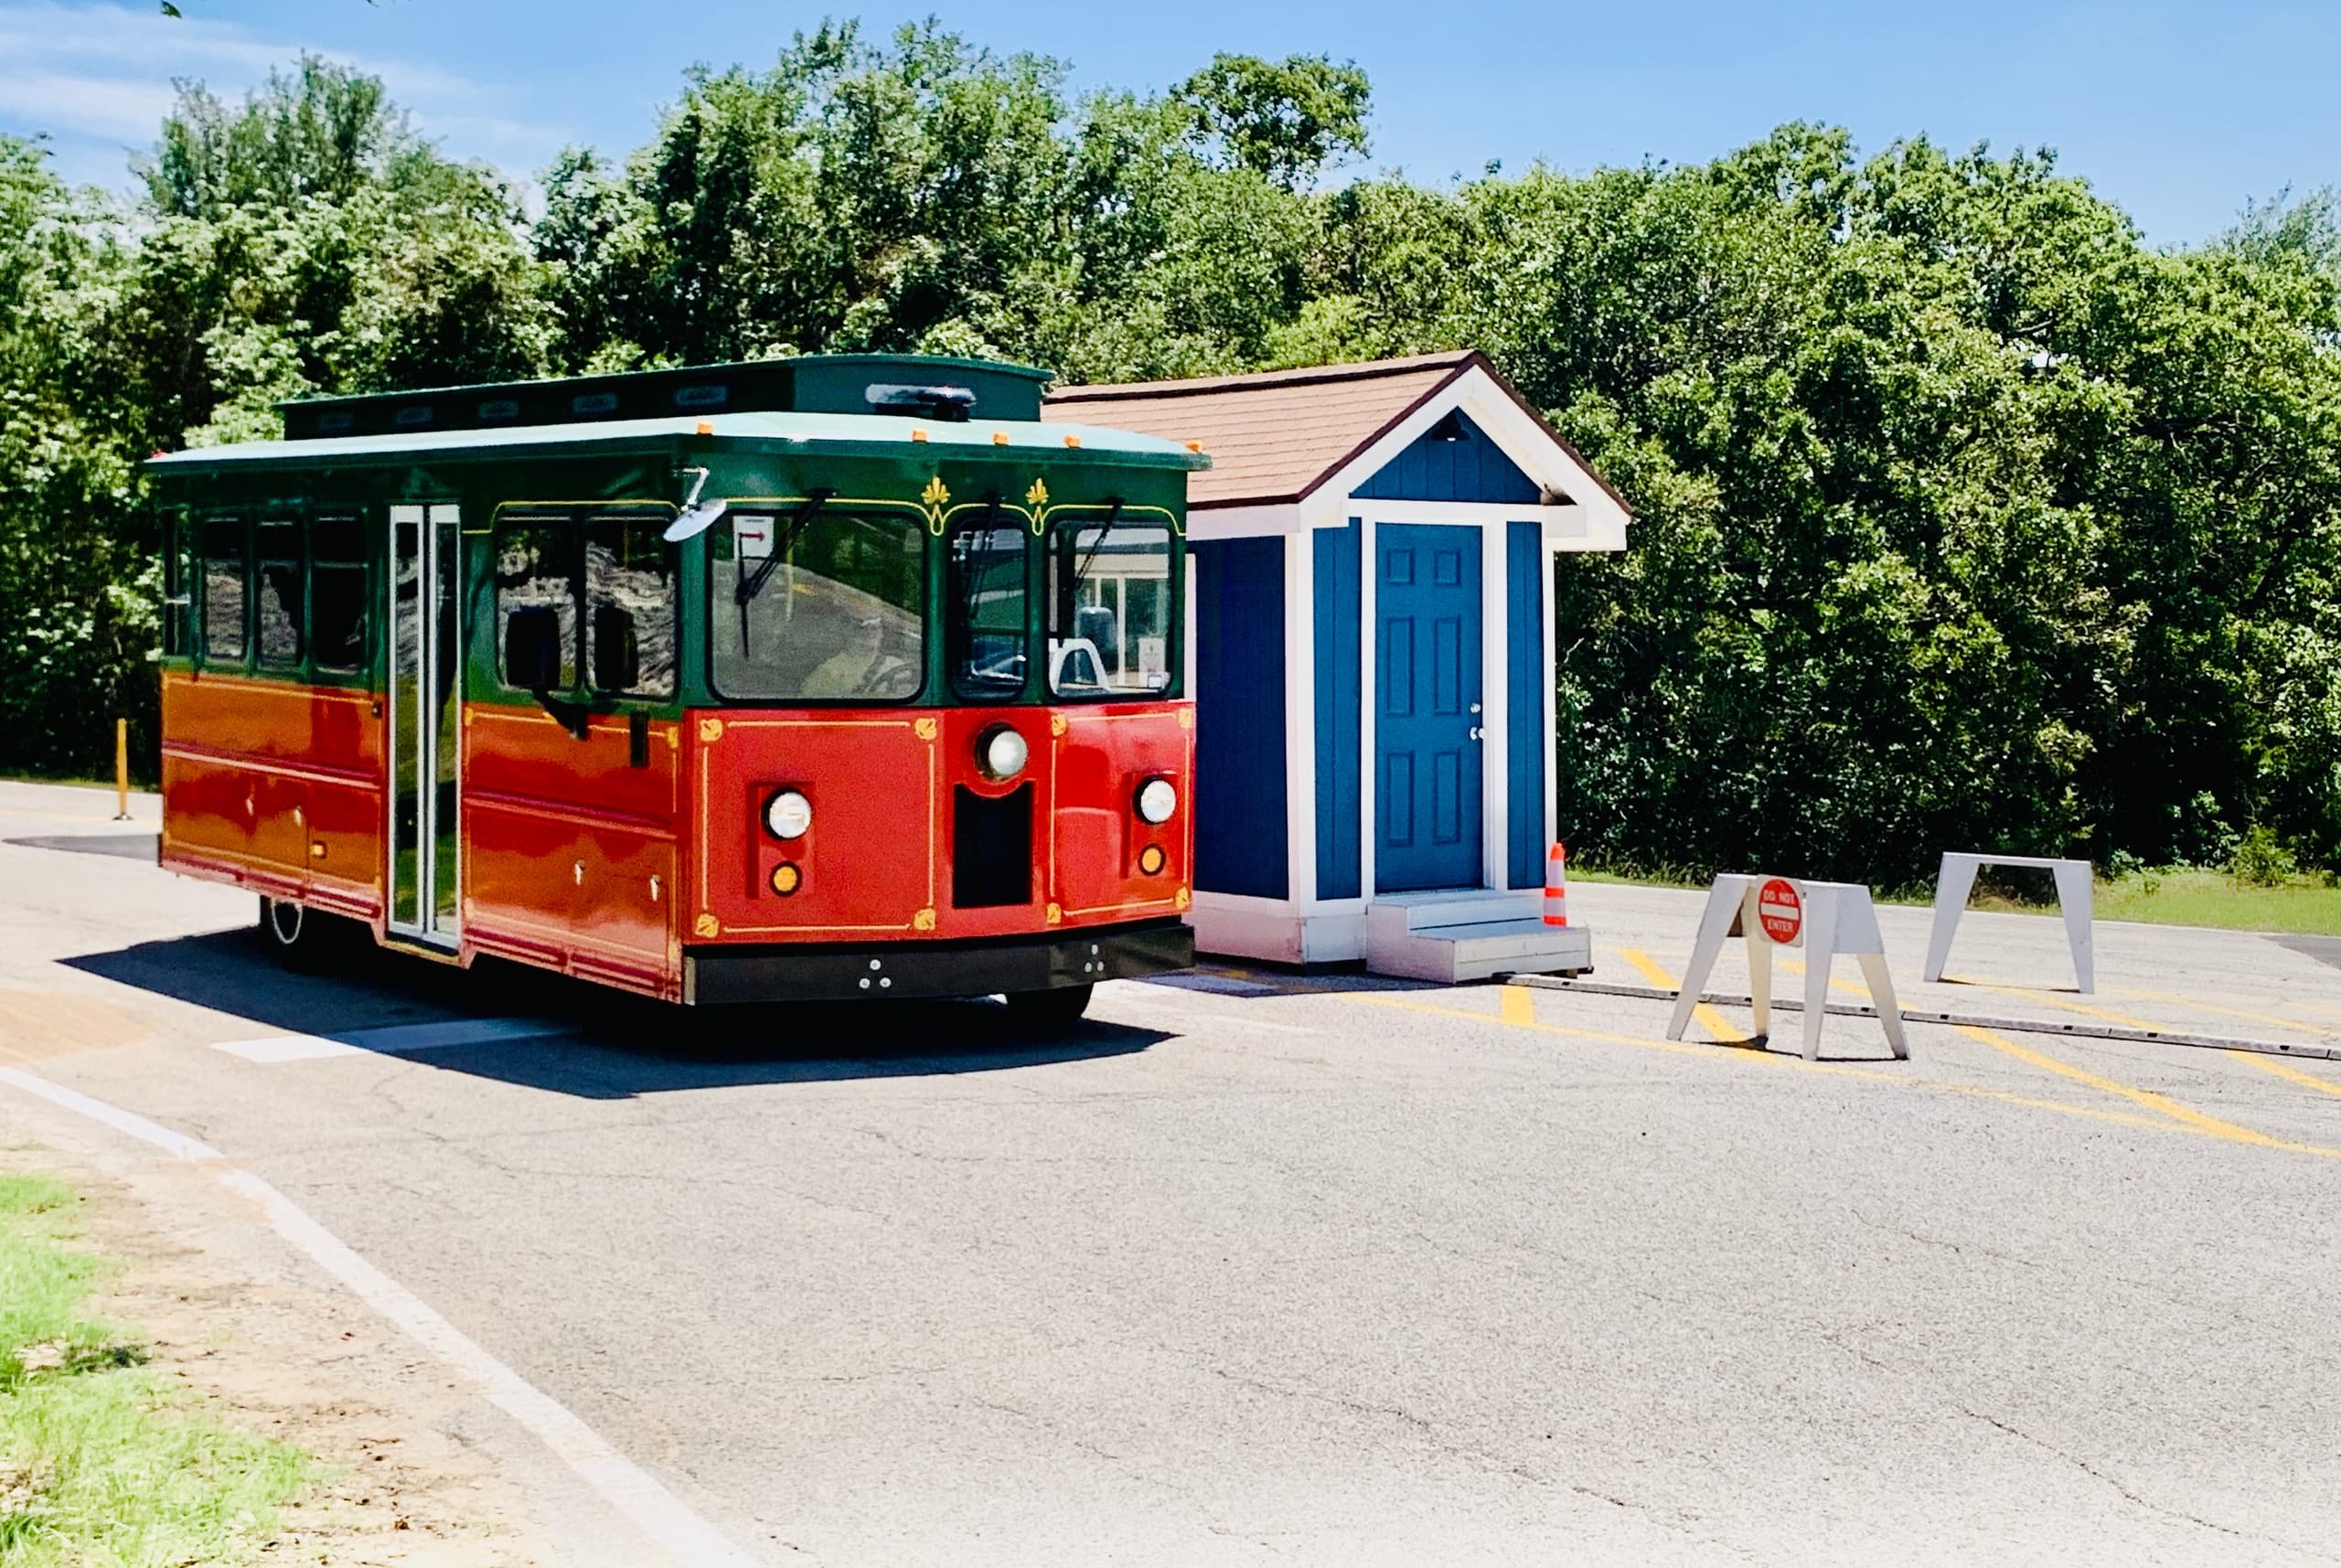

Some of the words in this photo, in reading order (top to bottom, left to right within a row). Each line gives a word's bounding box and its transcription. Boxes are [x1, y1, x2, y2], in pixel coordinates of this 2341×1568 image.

[1763, 890, 1775, 901] DO
[1779, 892, 1794, 903] NOT
[1768, 919, 1793, 932] ENTER
